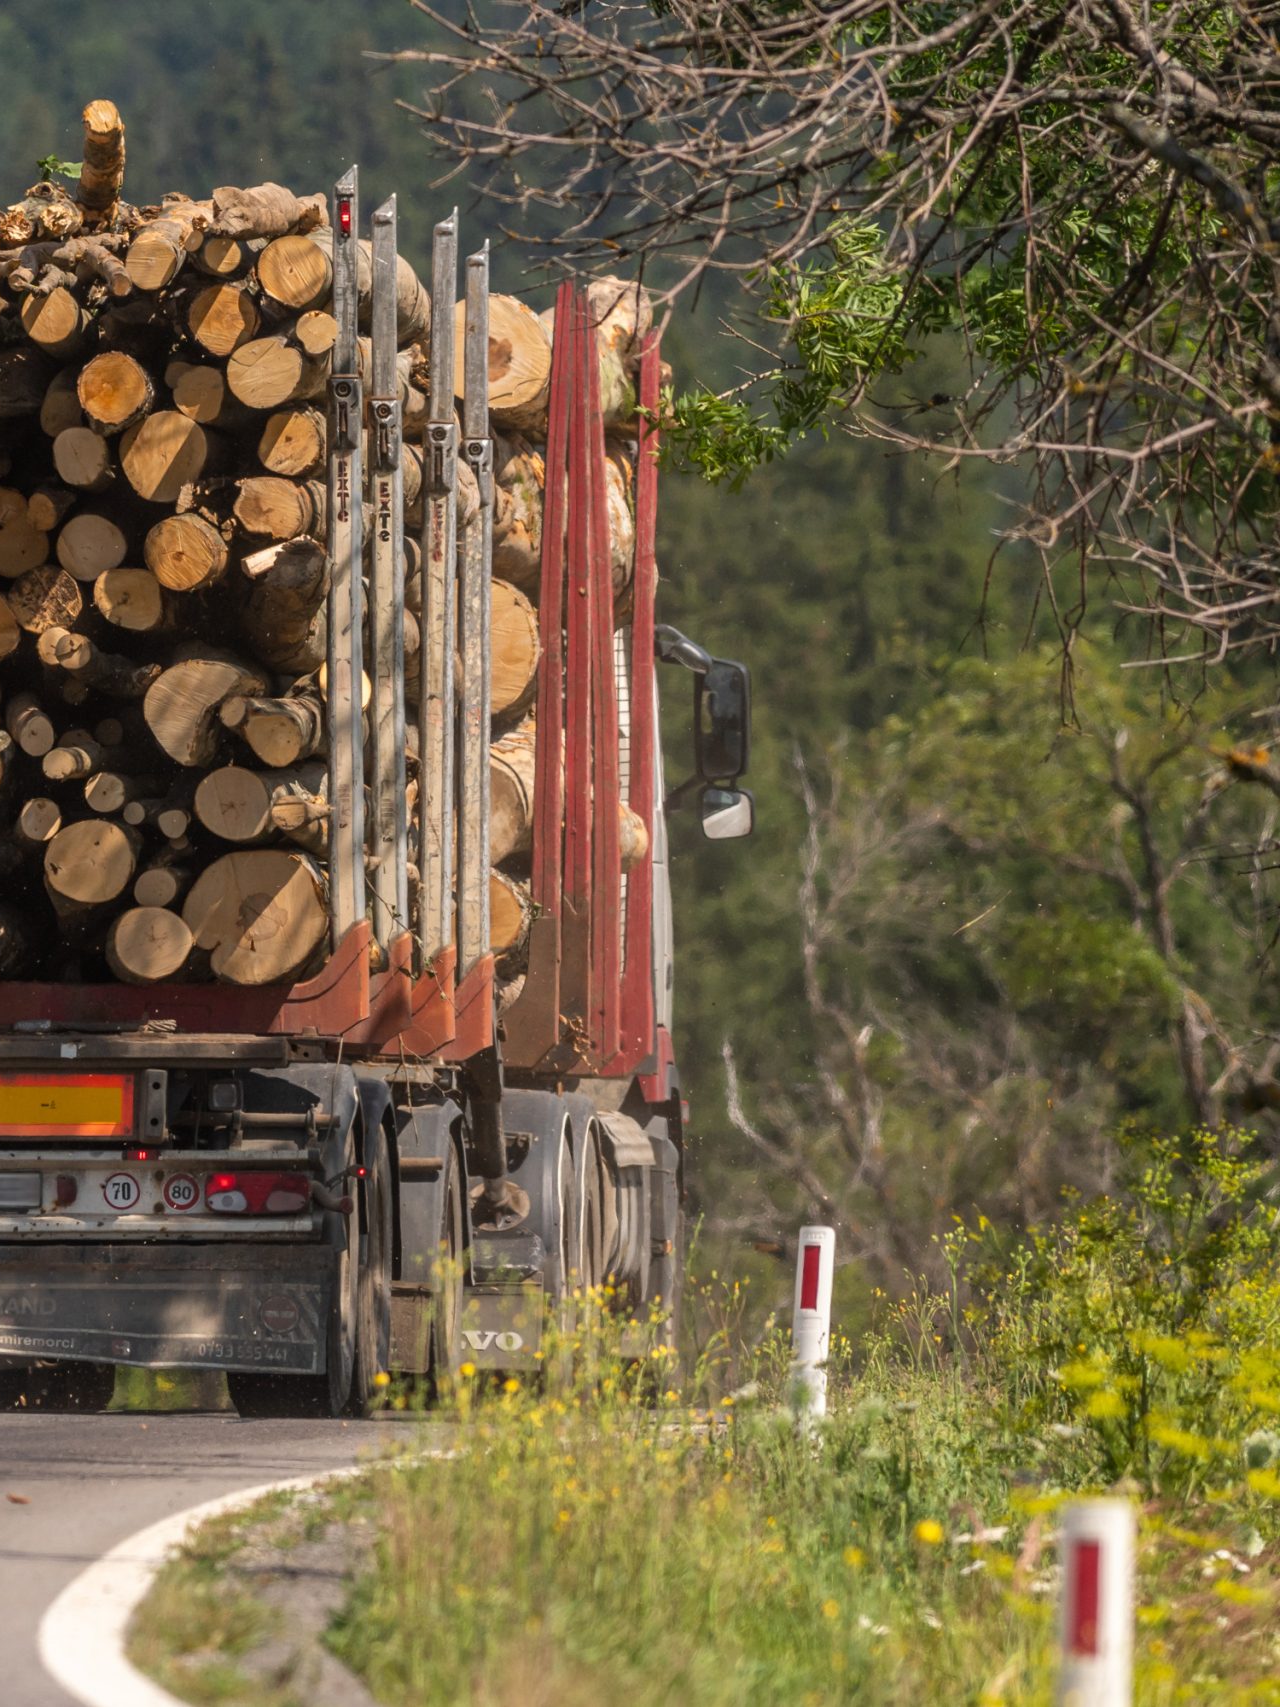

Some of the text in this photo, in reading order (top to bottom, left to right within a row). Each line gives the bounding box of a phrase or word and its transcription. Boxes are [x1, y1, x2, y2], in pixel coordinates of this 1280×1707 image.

[112, 1182, 131, 1200] 70
[172, 1184, 191, 1200] 80
[461, 1330, 523, 1352] VO
